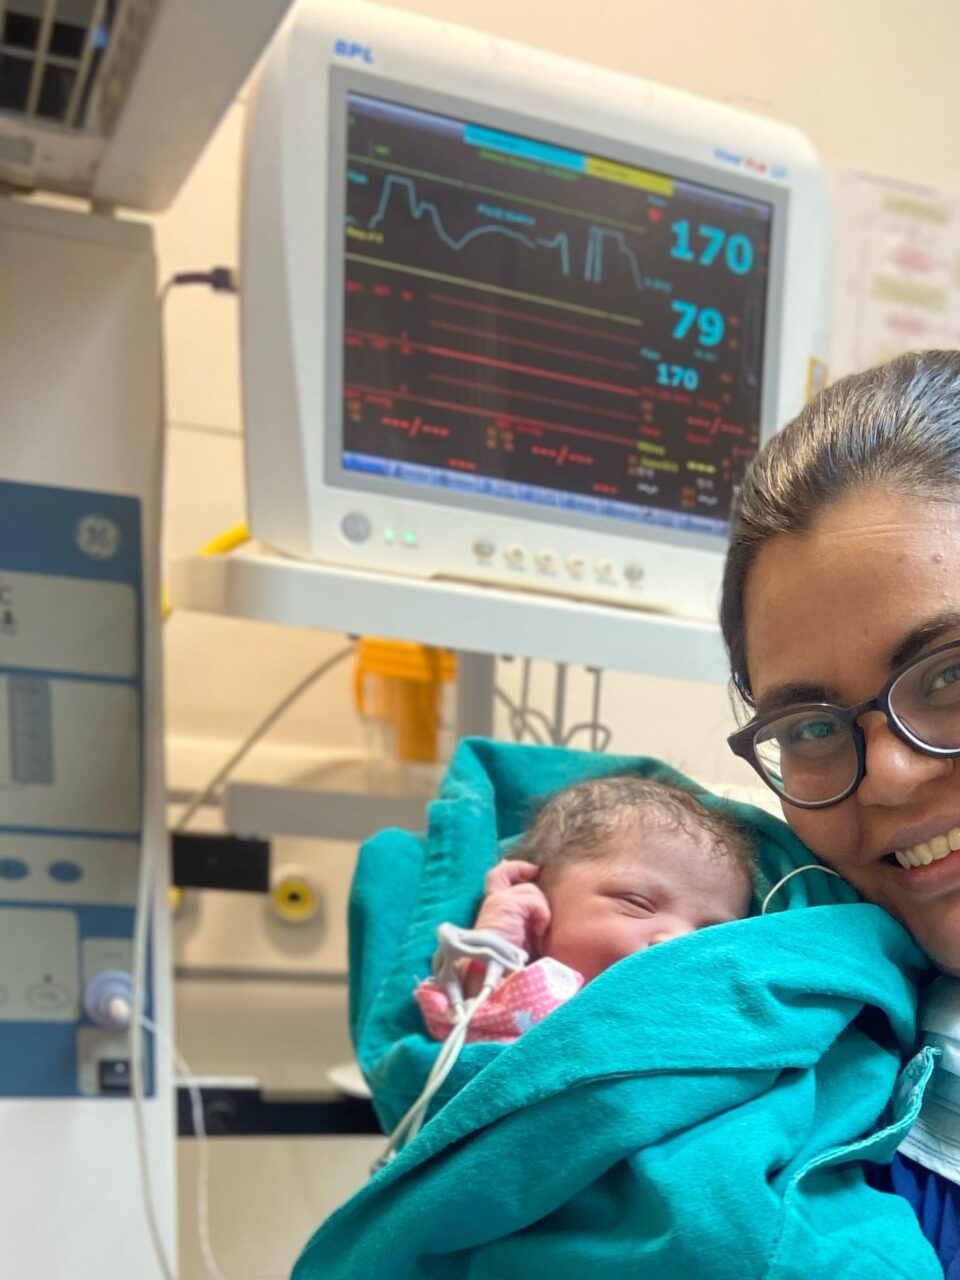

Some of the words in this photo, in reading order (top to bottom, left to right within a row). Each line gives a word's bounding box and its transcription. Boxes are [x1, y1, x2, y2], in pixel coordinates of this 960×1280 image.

[334, 38, 374, 64] BPL
[671, 220, 753, 274] 170
[671, 300, 724, 346] 79
[656, 362, 698, 391] 170
